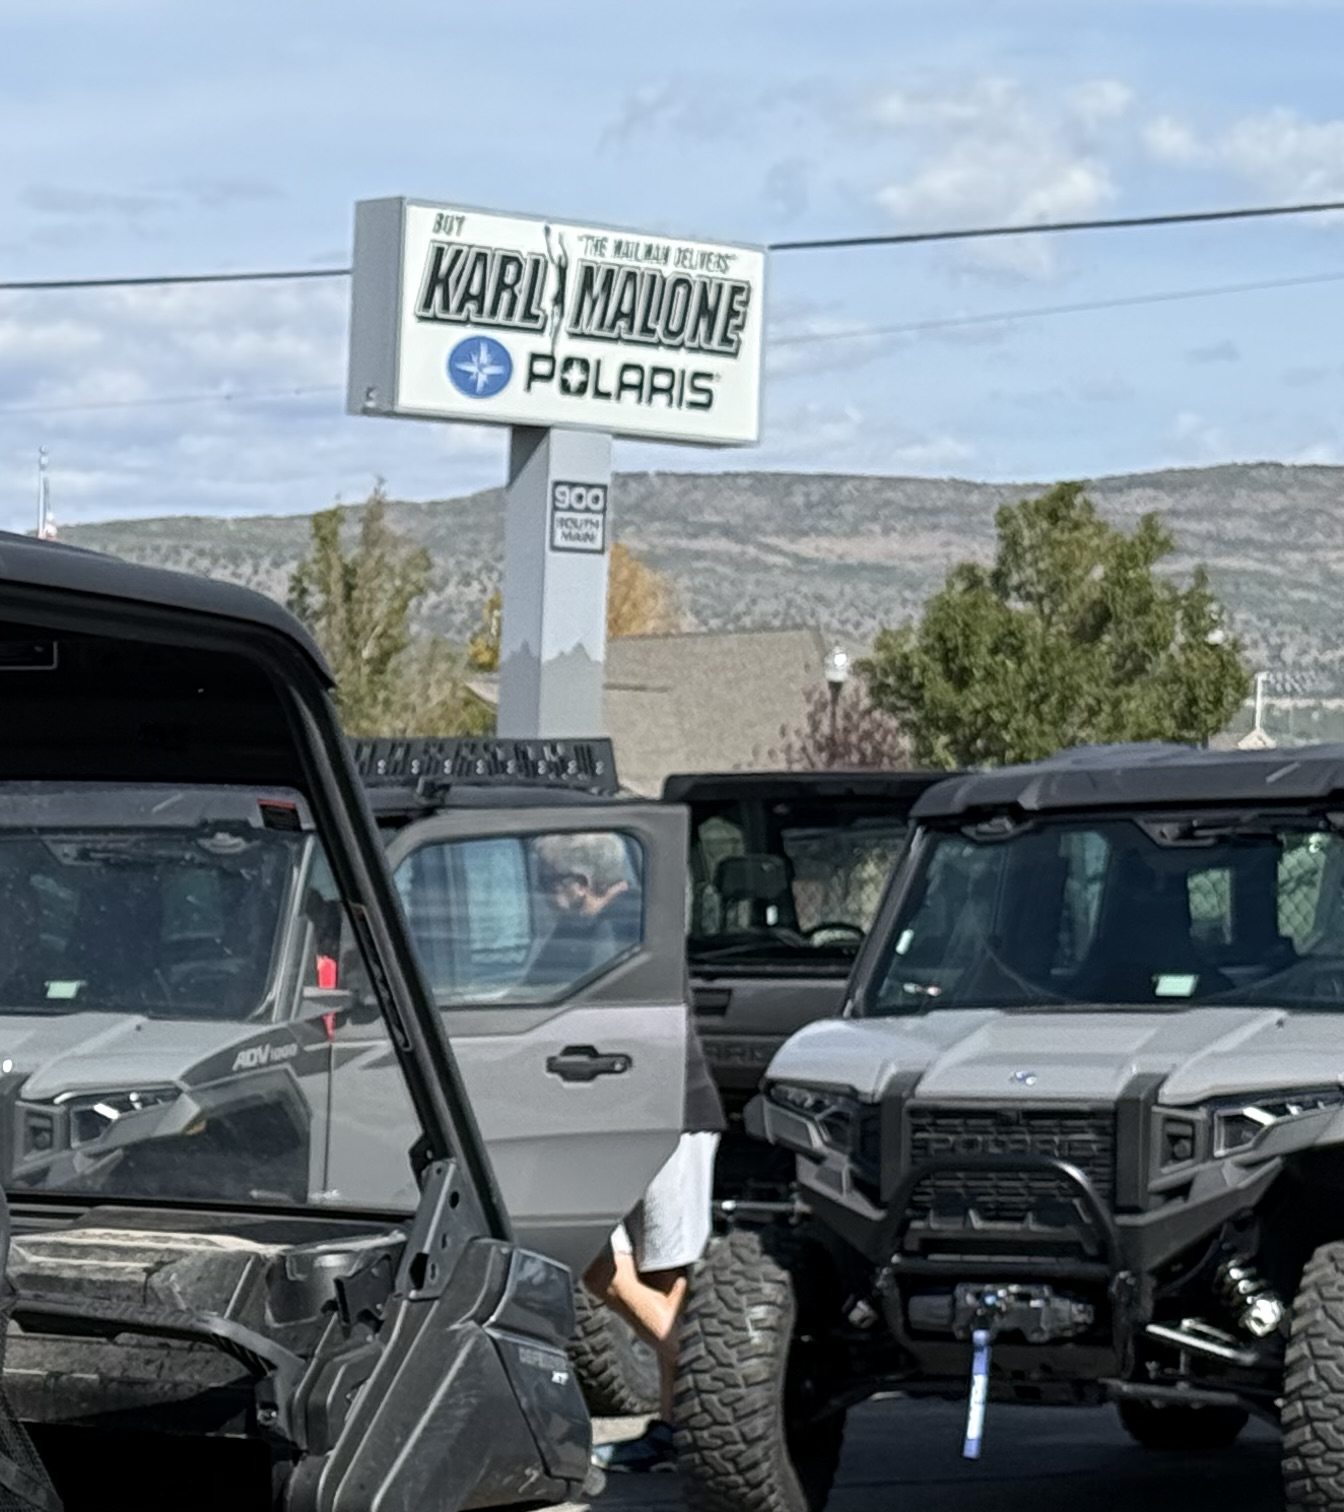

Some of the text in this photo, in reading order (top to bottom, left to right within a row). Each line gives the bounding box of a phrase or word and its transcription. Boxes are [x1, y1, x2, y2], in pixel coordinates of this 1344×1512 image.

[415, 240, 752, 359] KARL MALONE
[523, 352, 714, 411] POLARIS
[554, 485, 605, 510] 900
[556, 516, 600, 530] SOUTH
[560, 530, 596, 544] MAIN
